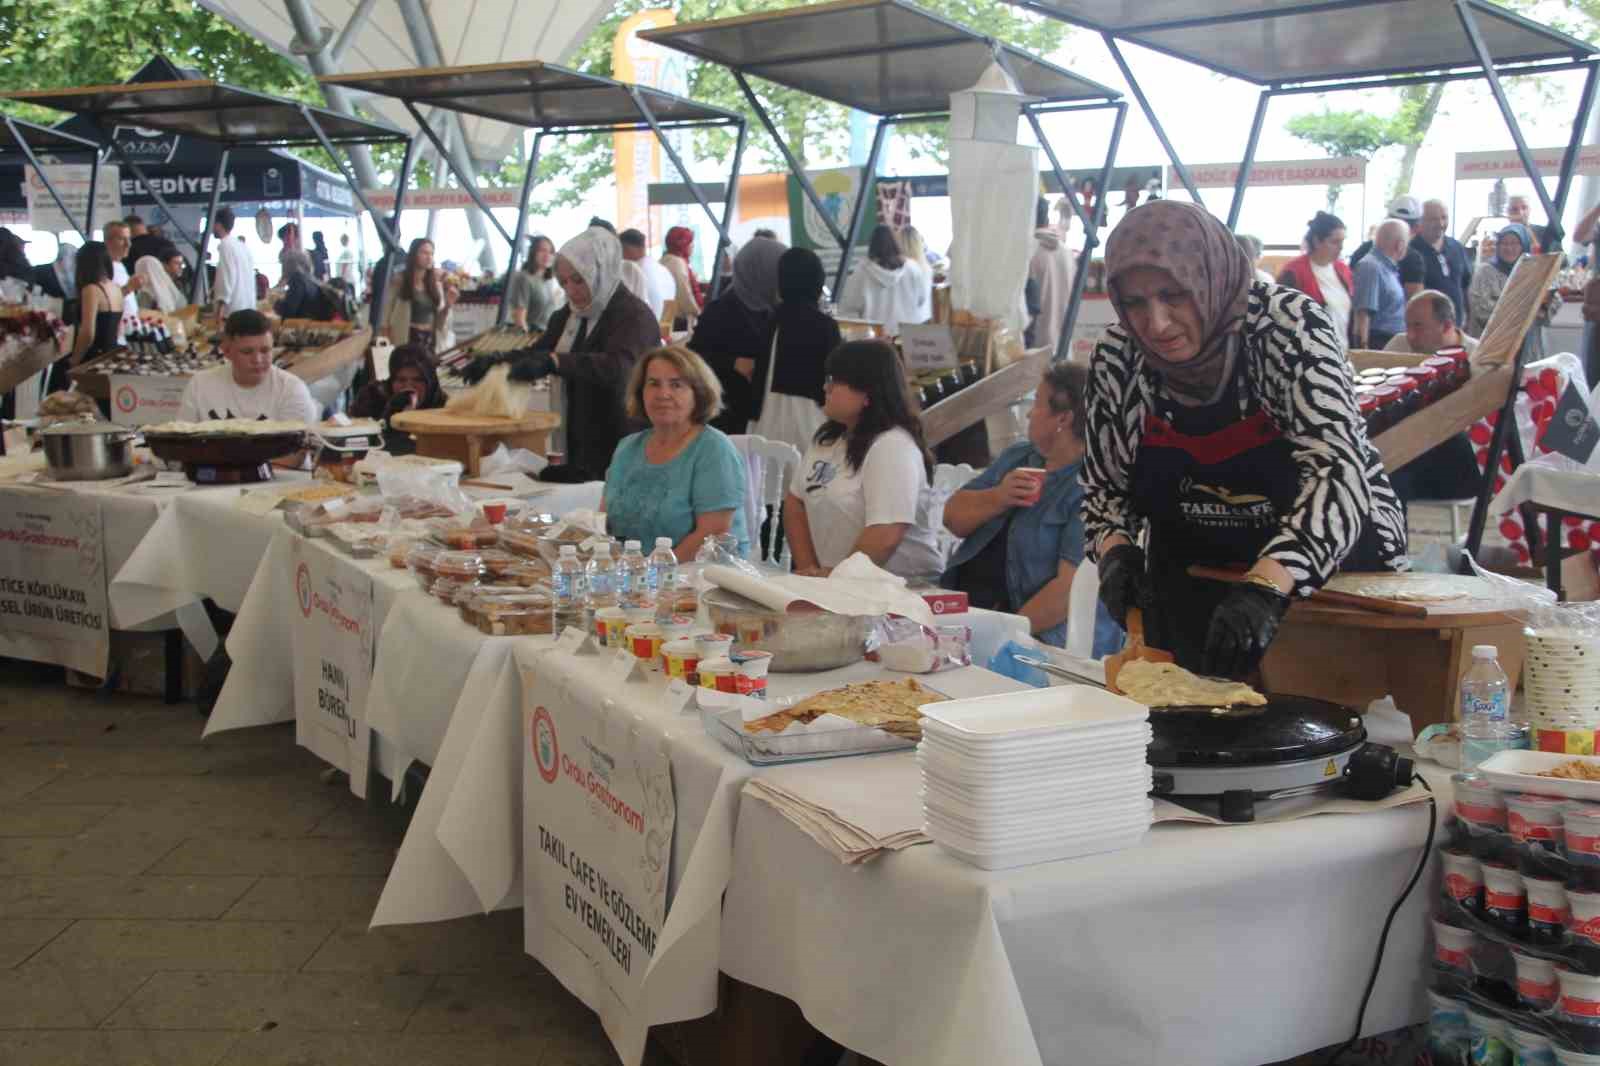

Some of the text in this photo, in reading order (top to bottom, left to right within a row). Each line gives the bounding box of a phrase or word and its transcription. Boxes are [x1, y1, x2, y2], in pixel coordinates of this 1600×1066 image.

[121, 175, 236, 196] ELEDİYESİ
[1180, 502, 1230, 515] TAKIL
[561, 752, 586, 789] Ordu
[586, 770, 645, 834] Gastronomi
[538, 824, 568, 869] TAKIL
[570, 851, 596, 894] CAFE
[596, 871, 610, 907] VE
[565, 883, 579, 914] EV
